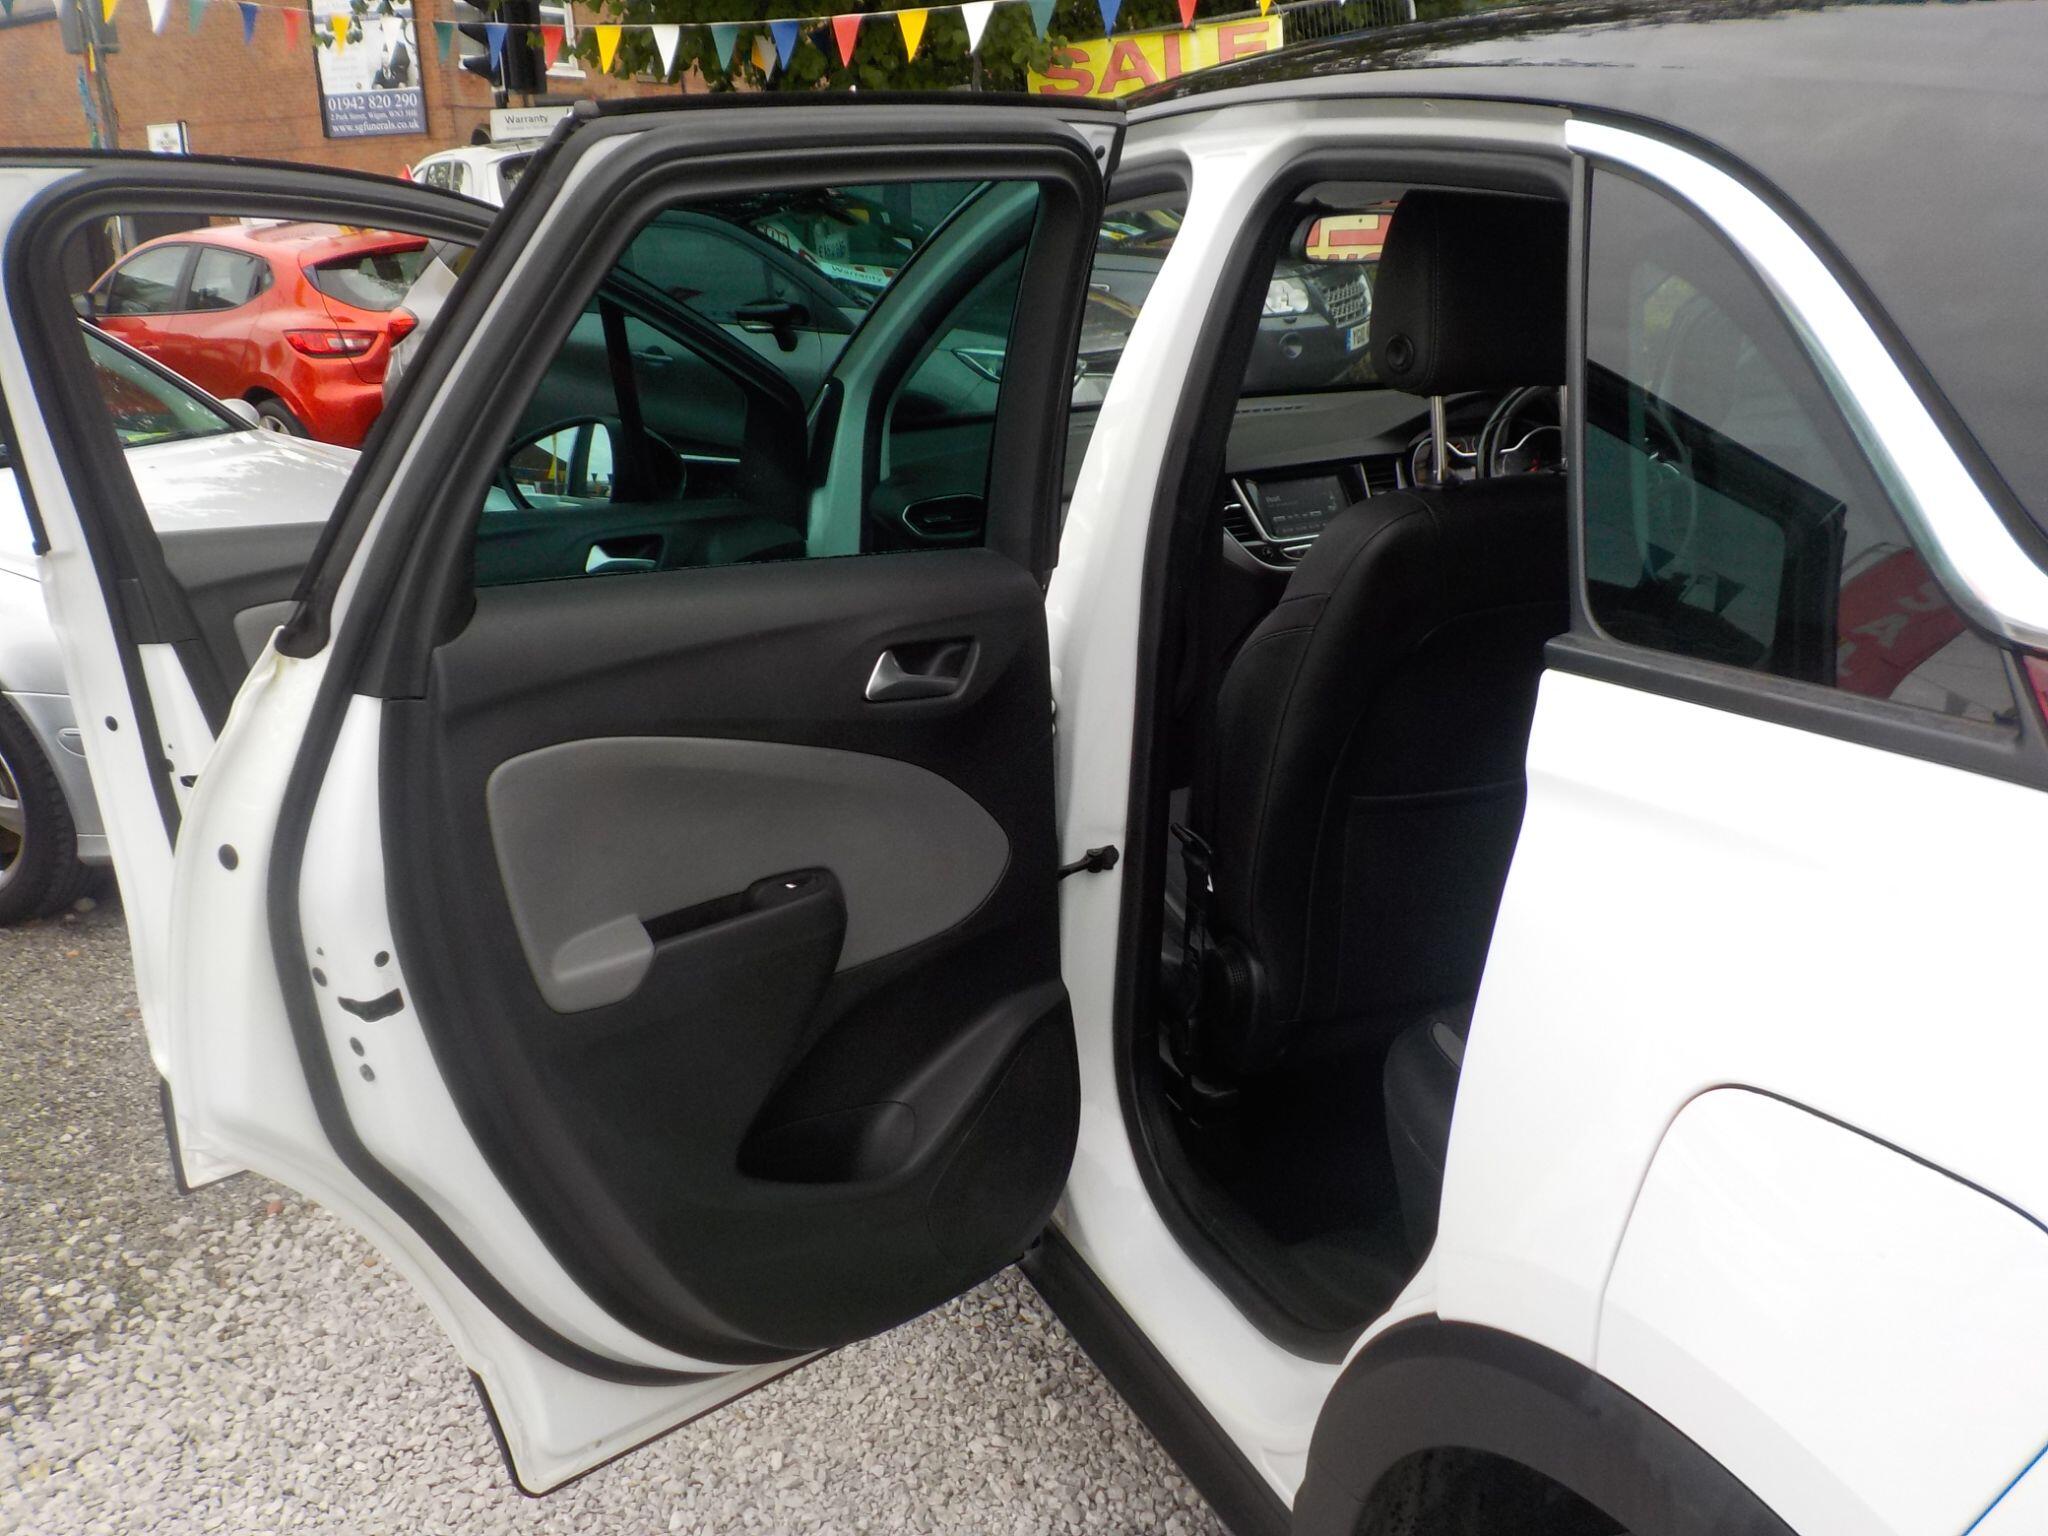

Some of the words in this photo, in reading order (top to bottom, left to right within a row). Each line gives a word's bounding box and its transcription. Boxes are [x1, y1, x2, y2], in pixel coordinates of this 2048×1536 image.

[328, 97, 363, 109] 01942
[368, 95, 391, 108] 820
[395, 93, 418, 107] 290
[504, 114, 548, 124] Warranty
